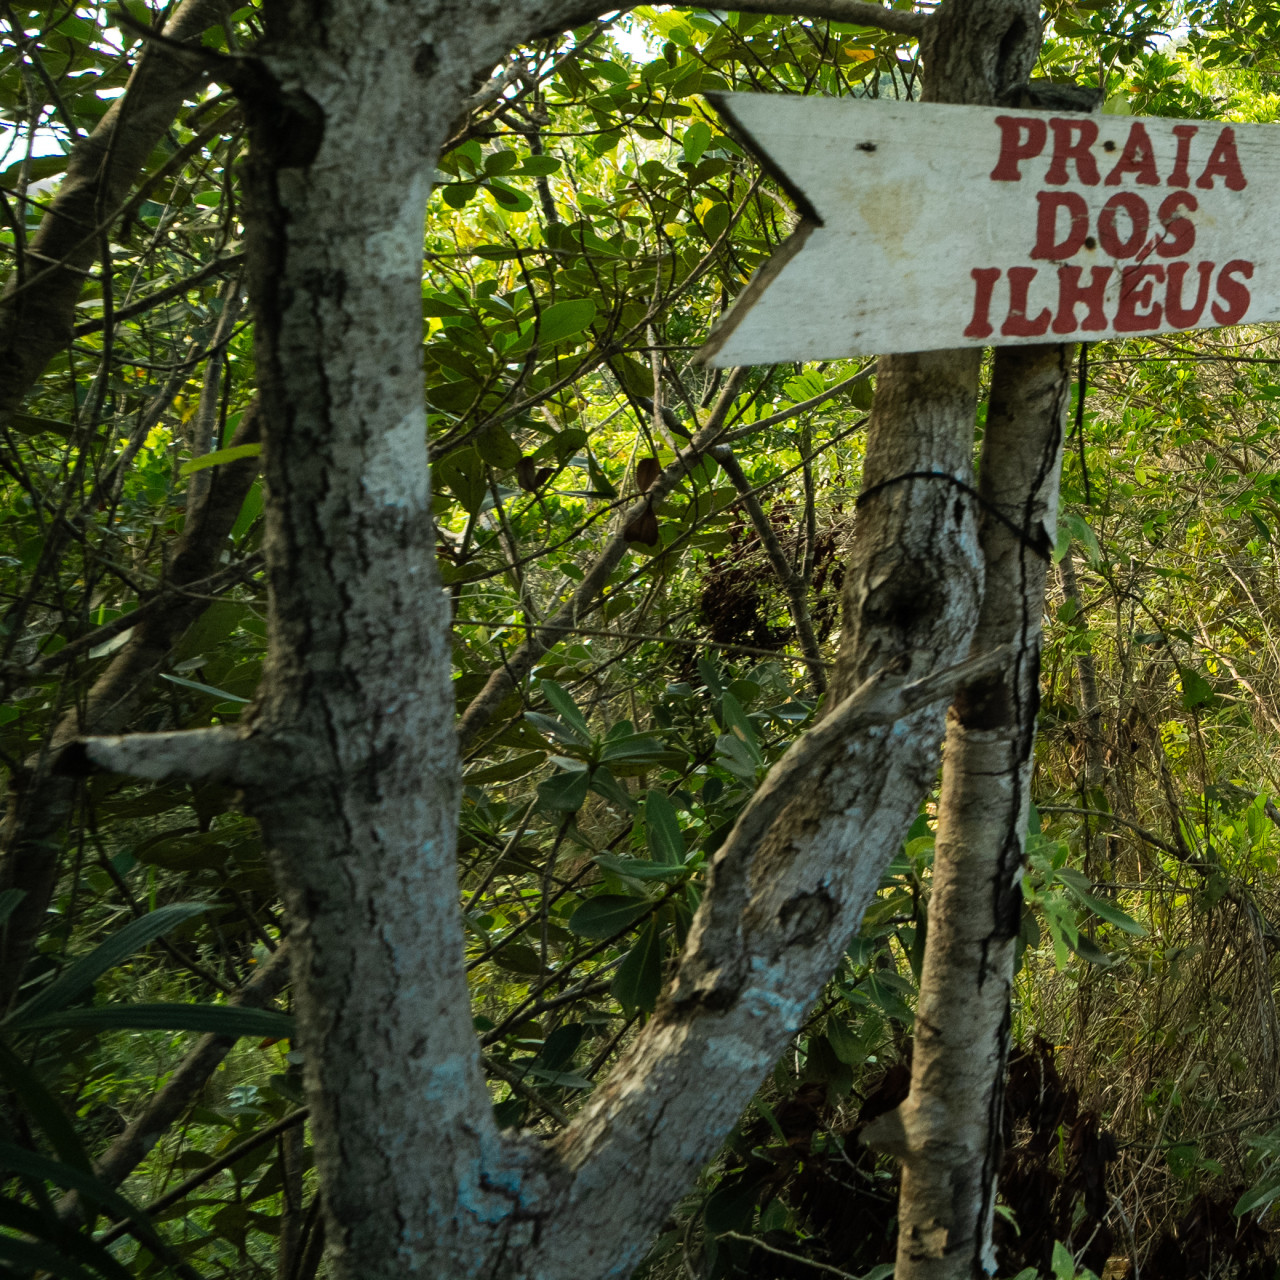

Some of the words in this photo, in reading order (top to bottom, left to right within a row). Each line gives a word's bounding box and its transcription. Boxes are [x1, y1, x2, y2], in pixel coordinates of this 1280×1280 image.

[991, 116, 1248, 191] PRAIA
[1030, 191, 1198, 260] DOS
[963, 234, 1254, 338] ILHÉUS
